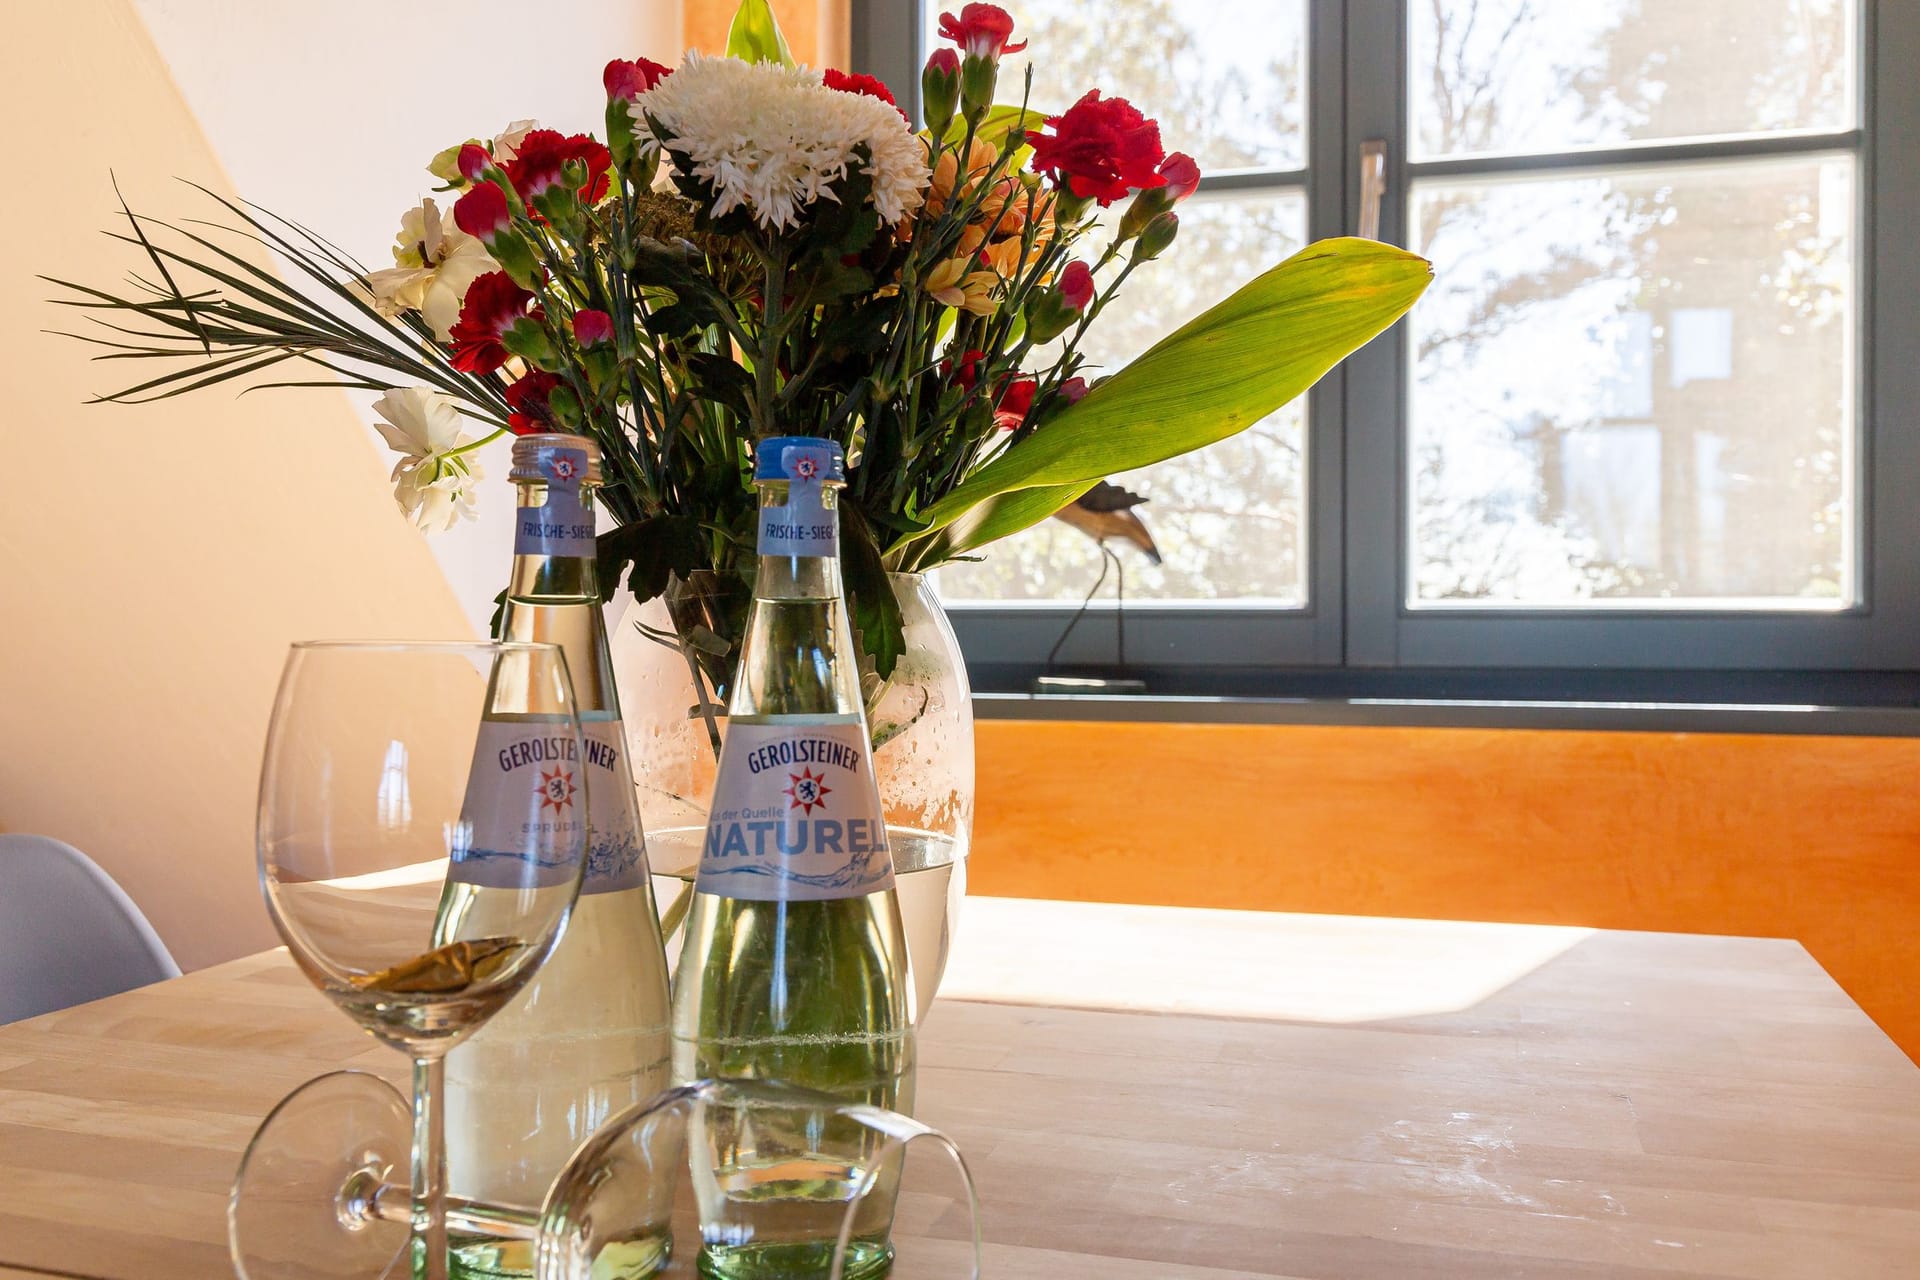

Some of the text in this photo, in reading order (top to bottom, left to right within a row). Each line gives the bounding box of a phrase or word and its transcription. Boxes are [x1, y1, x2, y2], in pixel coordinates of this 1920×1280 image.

[765, 523, 834, 541] FRISCHE-SIEG
[499, 737, 617, 772] GEROLSTEINER
[748, 739, 859, 774] GEROLSTEINER
[721, 809, 738, 821] der
[742, 806, 784, 820] Quelle
